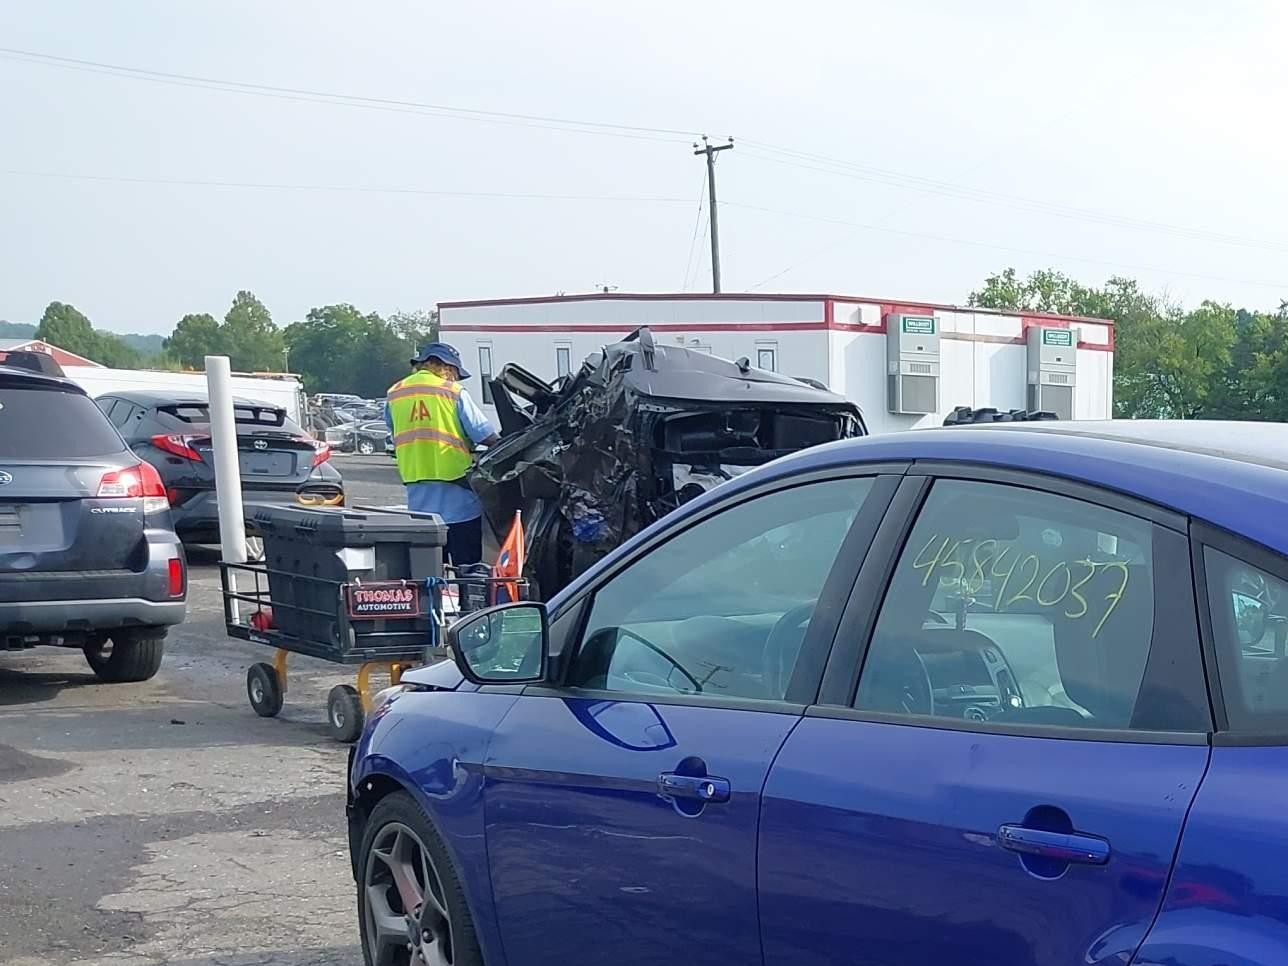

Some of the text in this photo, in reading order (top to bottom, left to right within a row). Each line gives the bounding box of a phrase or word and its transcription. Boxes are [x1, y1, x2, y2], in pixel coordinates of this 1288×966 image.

[913, 534, 1132, 639] 45842037
[354, 589, 414, 603] THOMAS
[356, 603, 412, 611] AUTOMOTIVE
